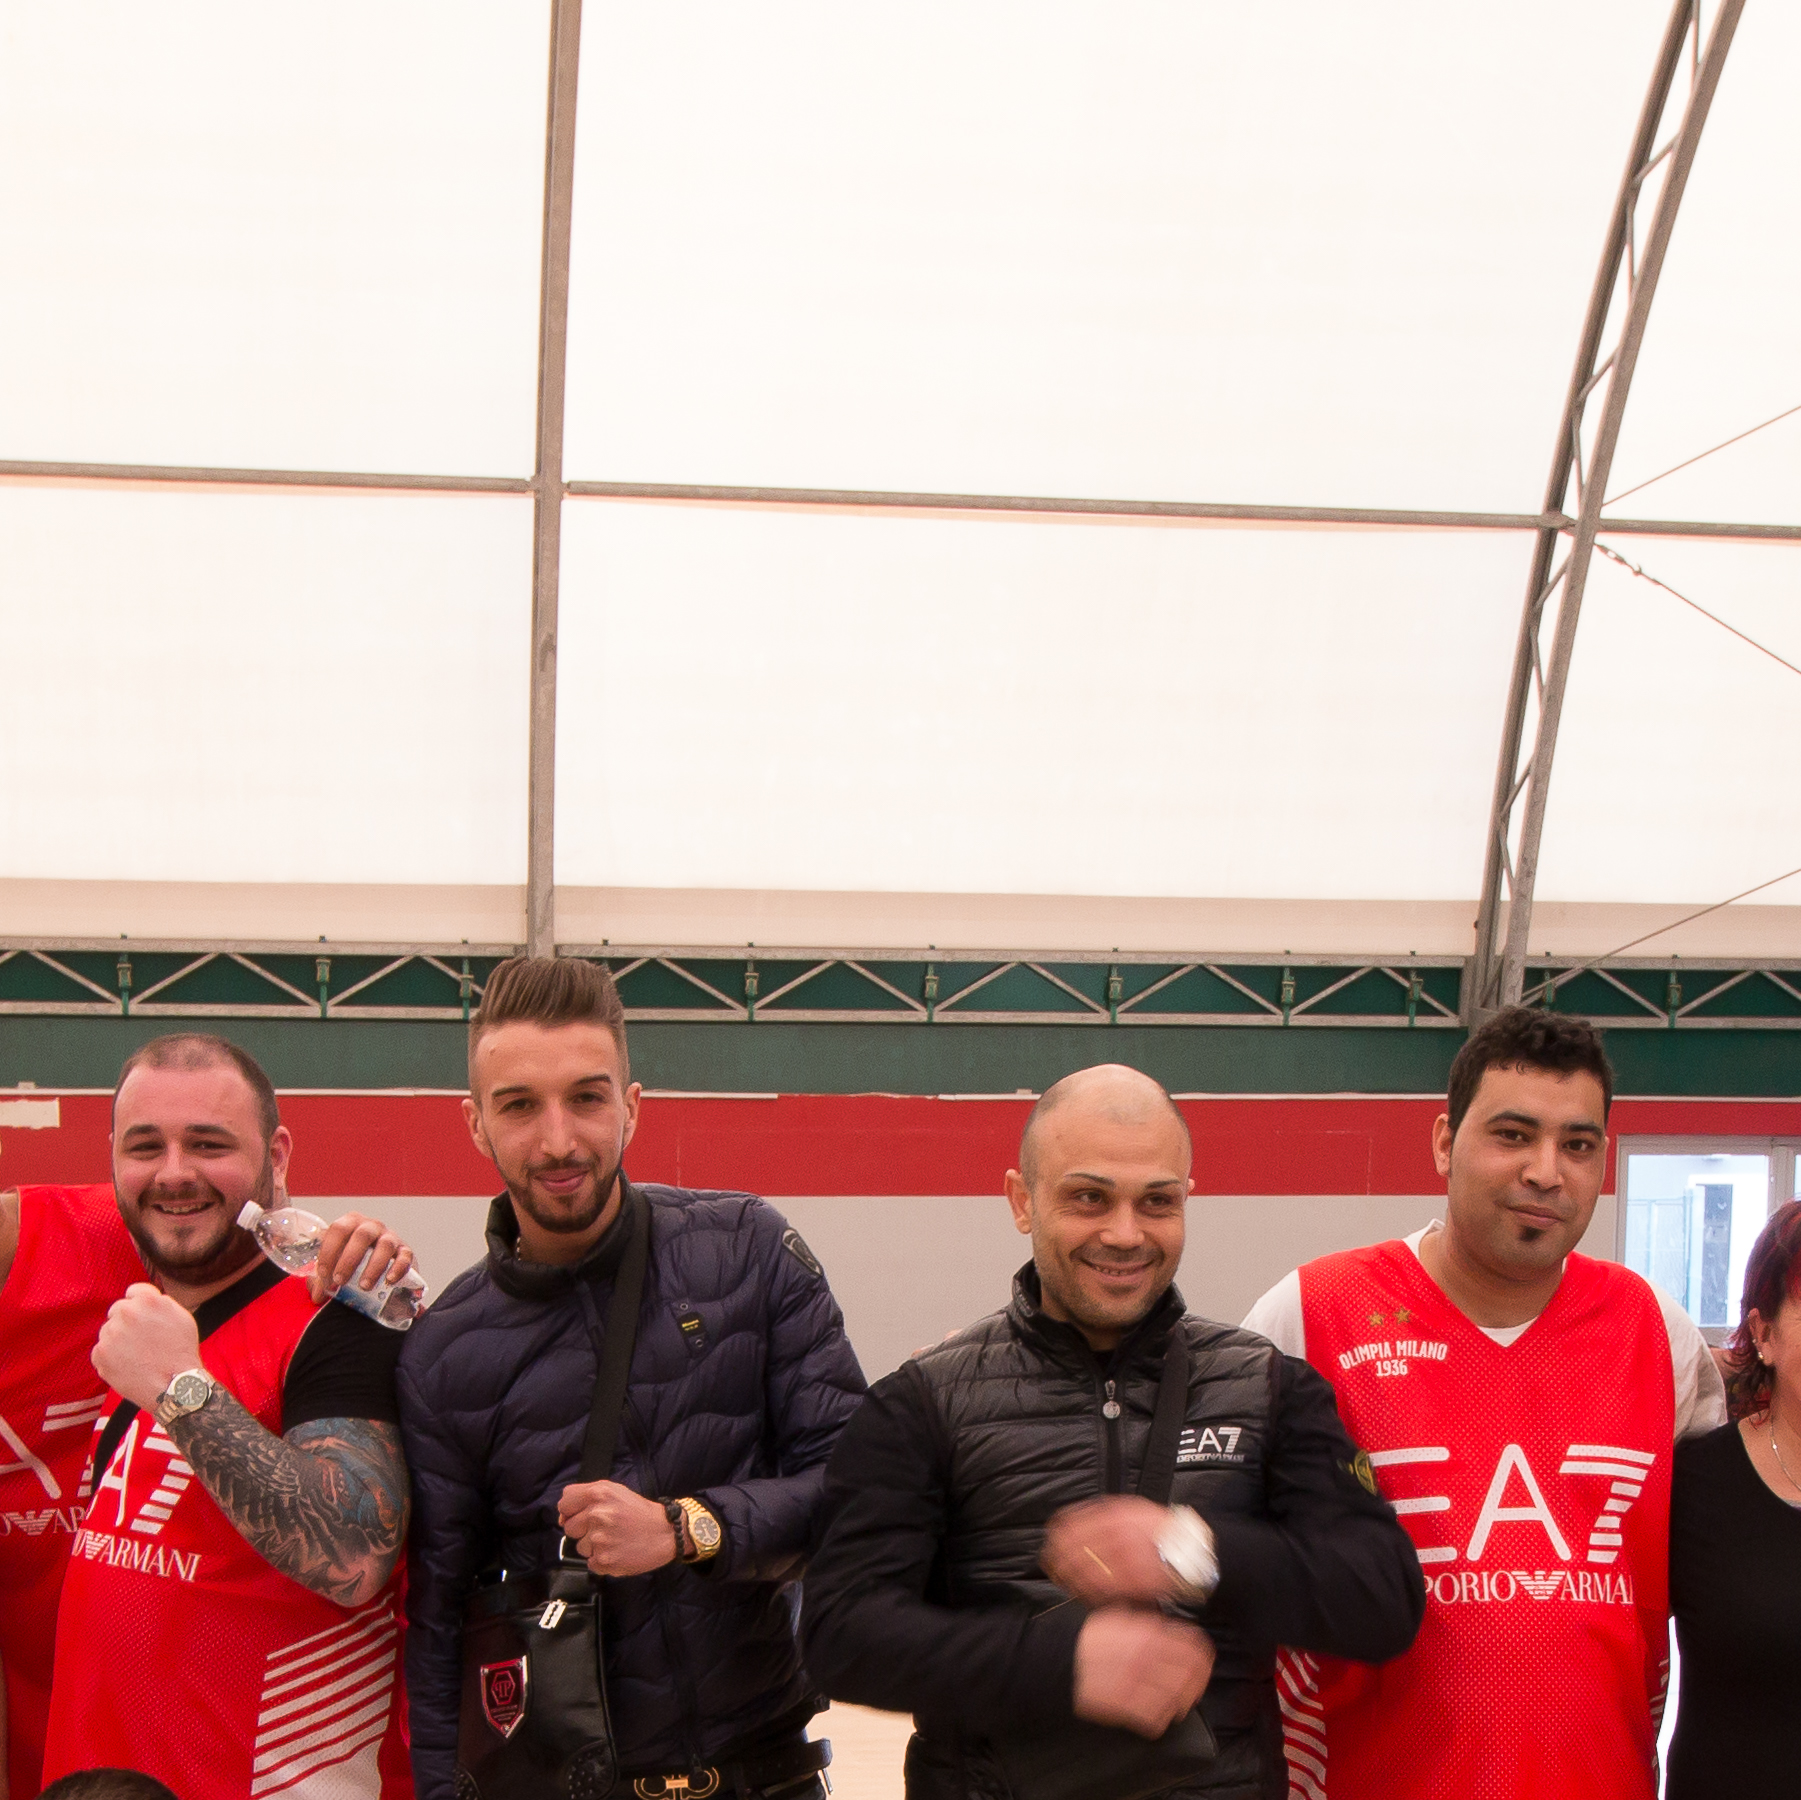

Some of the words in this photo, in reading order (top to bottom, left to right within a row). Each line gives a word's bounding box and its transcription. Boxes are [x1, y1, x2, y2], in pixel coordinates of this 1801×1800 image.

[1338, 1341, 1392, 1370] OLIMPIA
[1396, 1340, 1448, 1361] MILANO
[1375, 1359, 1408, 1377] 1936
[100, 1533, 202, 1583] ARMANI
[1423, 1570, 1517, 1605] PORIO
[1560, 1571, 1634, 1605] ARMA
